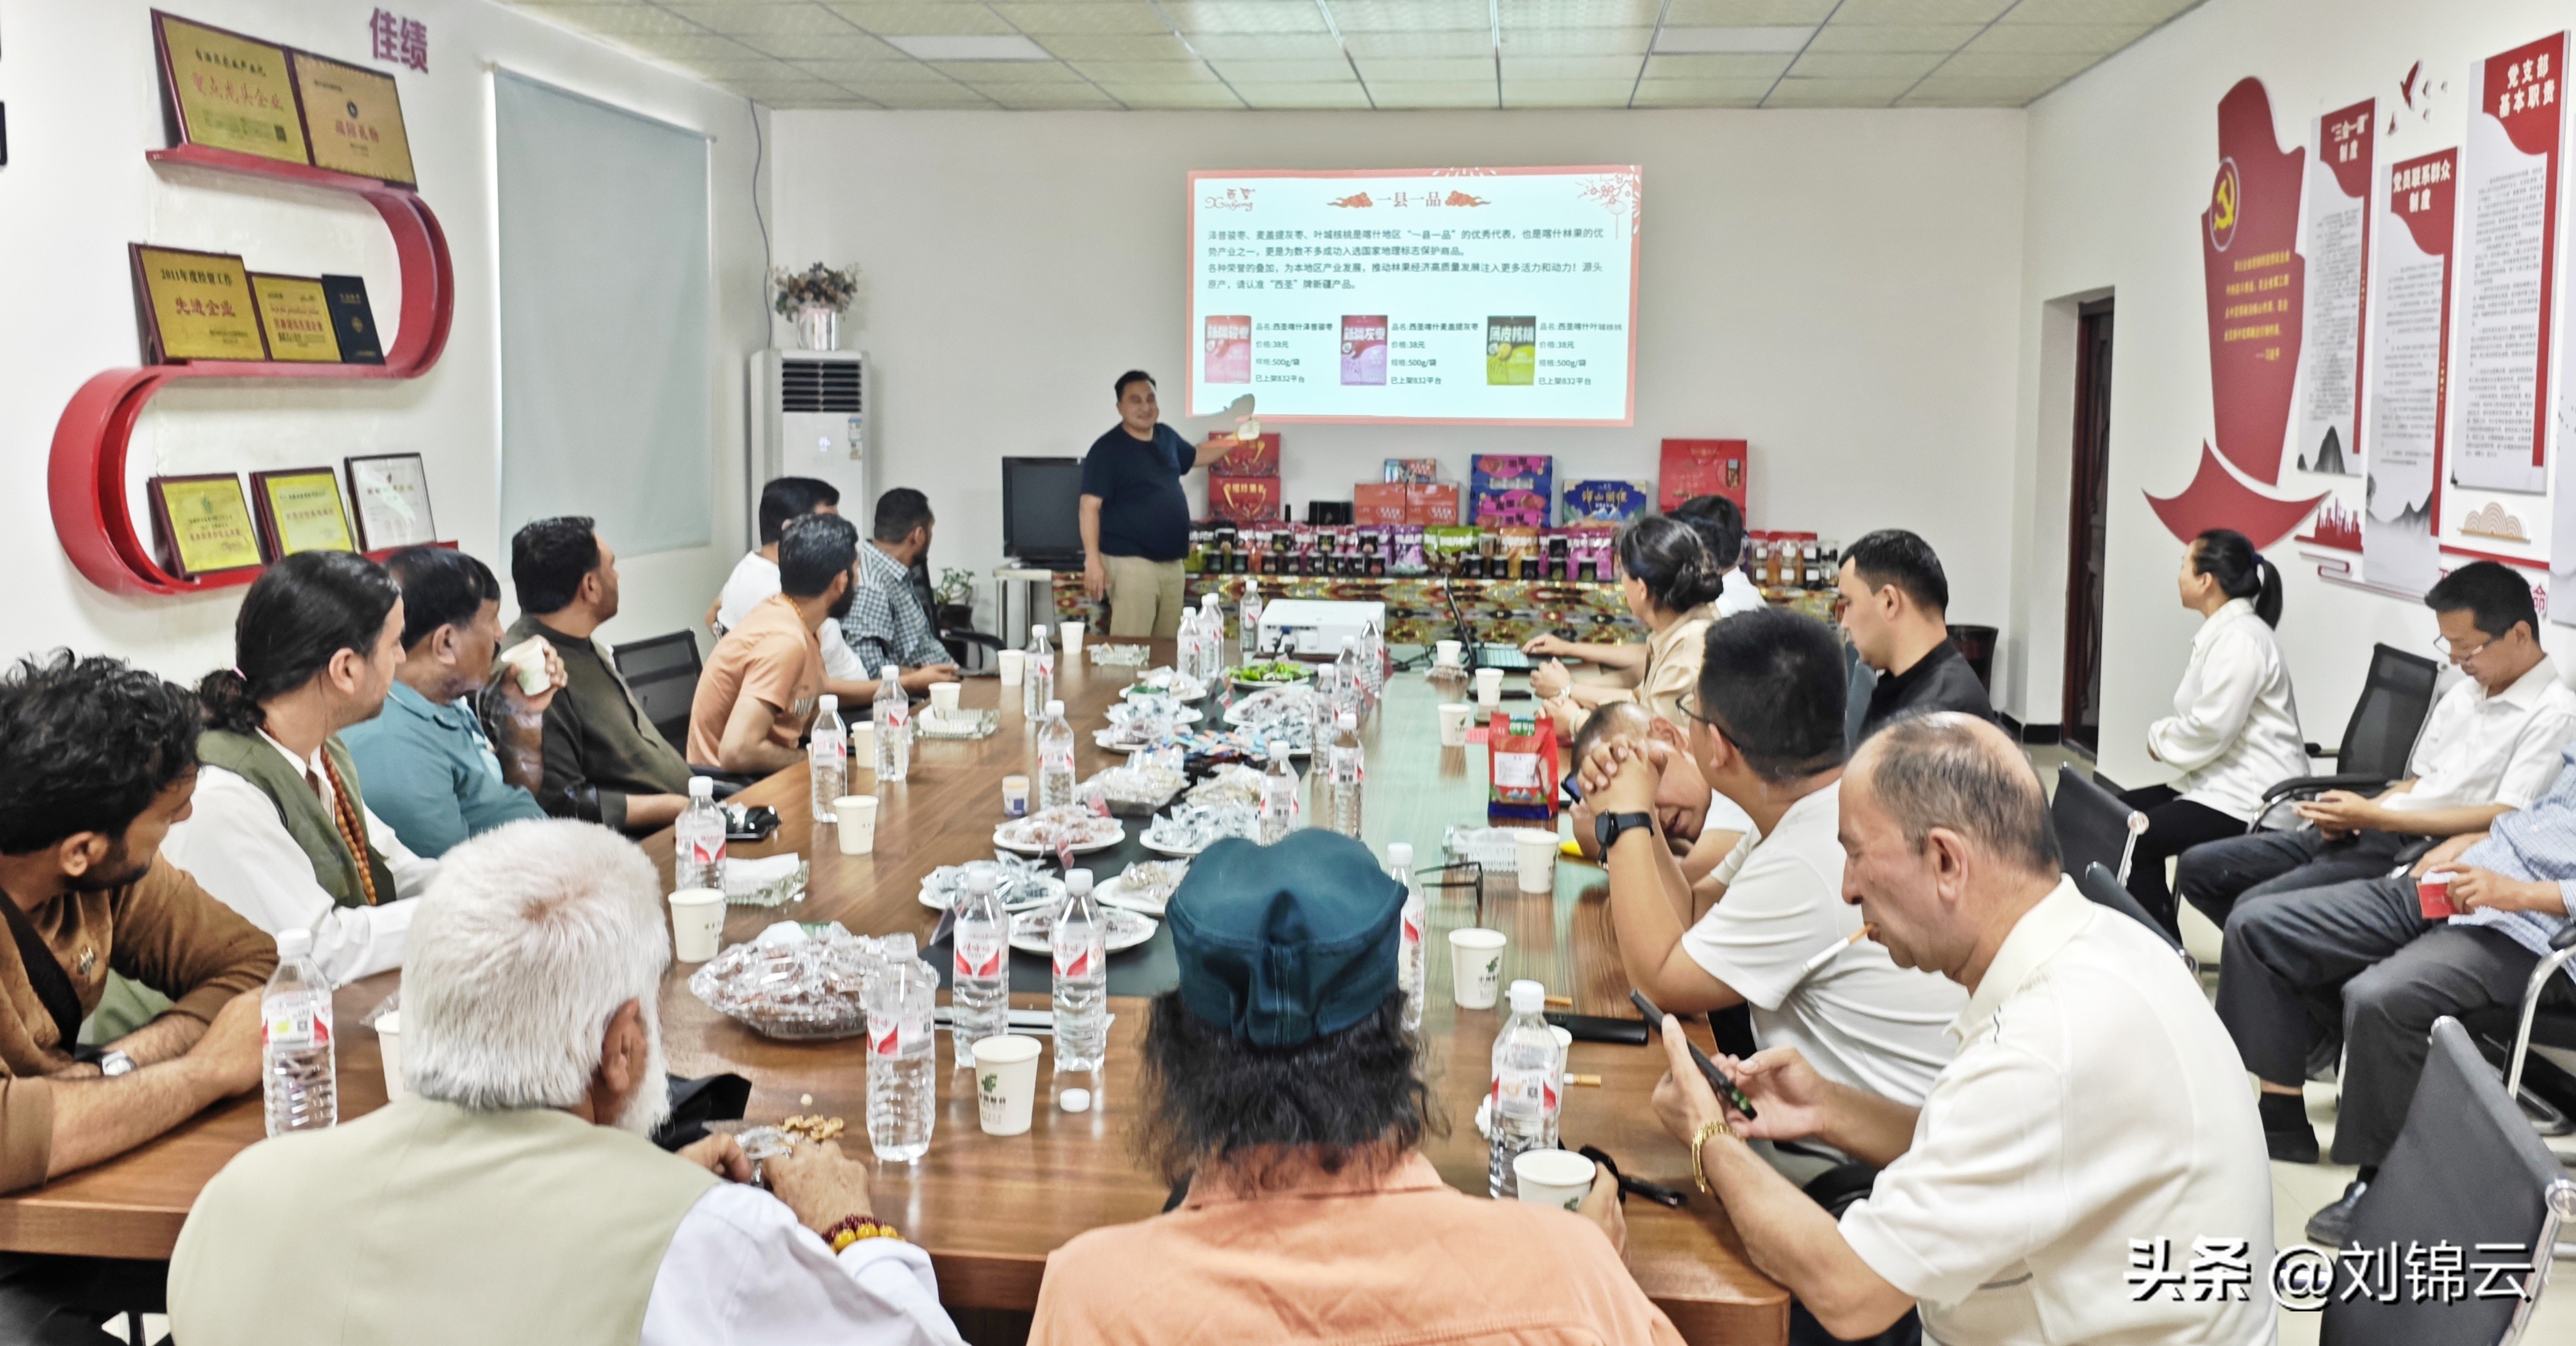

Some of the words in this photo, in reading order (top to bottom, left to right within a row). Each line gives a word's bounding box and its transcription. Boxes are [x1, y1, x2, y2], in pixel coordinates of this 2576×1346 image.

[369, 8, 429, 74] 佳绩
[2507, 53, 2549, 89] 党支部
[2499, 79, 2555, 118] 基本职责
[1376, 191, 1441, 208] 一县一品
[176, 296, 236, 318] 先进企业
